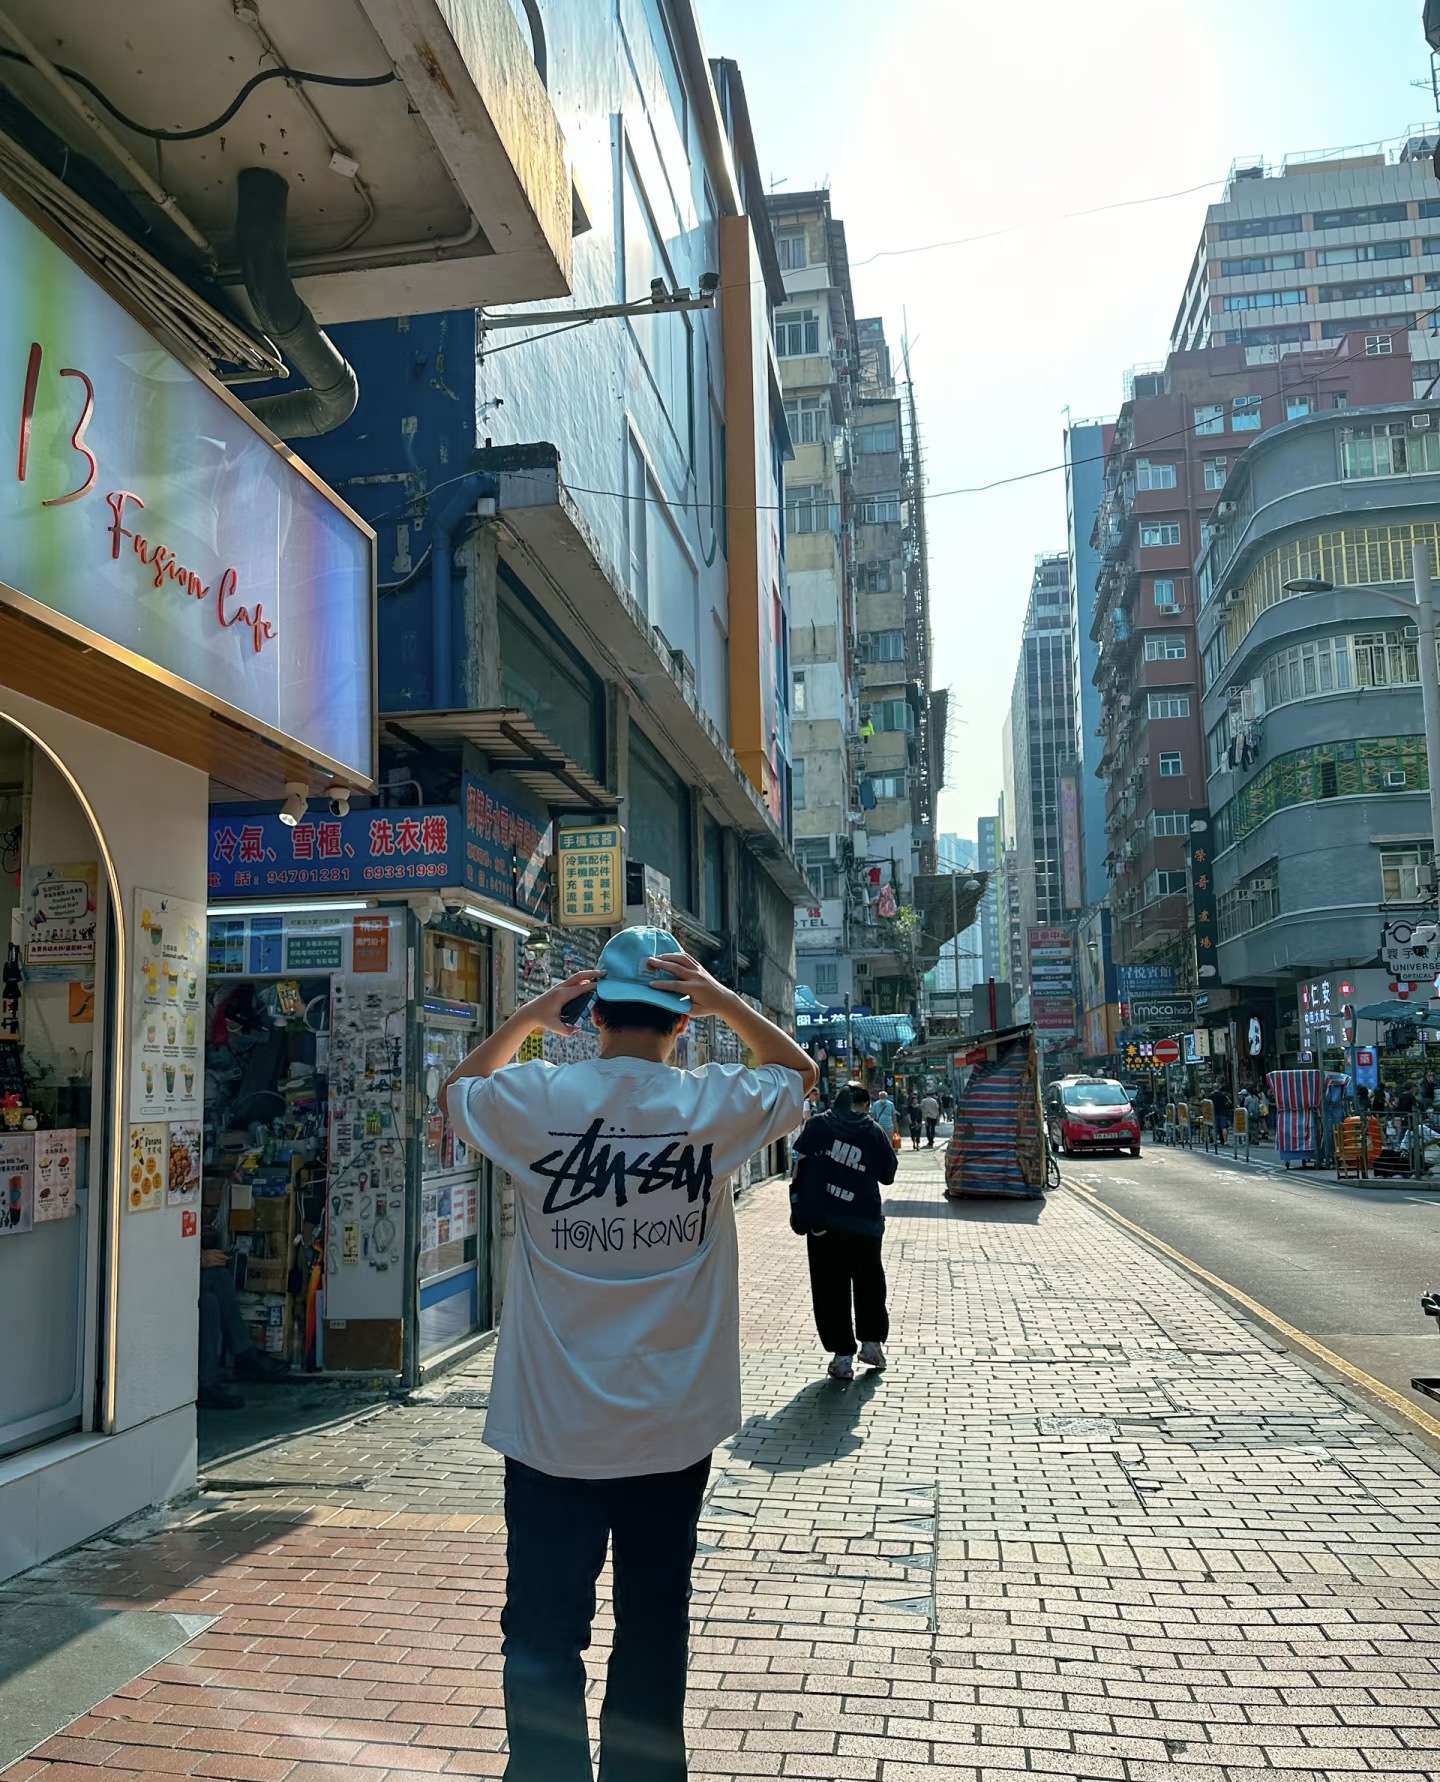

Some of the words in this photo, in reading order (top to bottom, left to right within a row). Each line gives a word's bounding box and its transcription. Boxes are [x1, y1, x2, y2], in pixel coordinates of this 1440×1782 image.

[106, 490, 210, 600] Fusion
[563, 833, 612, 848] 手機電器
[566, 854, 610, 866] 冷氣配件
[267, 868, 350, 884] 94701281
[364, 863, 448, 880] 69331998
[566, 866, 610, 878] 手機配件
[1393, 963, 1440, 971] UNIVERSE
[1138, 1005, 1174, 1016] moca
[552, 1218, 626, 1252] HONG
[633, 1211, 699, 1249] KONG
